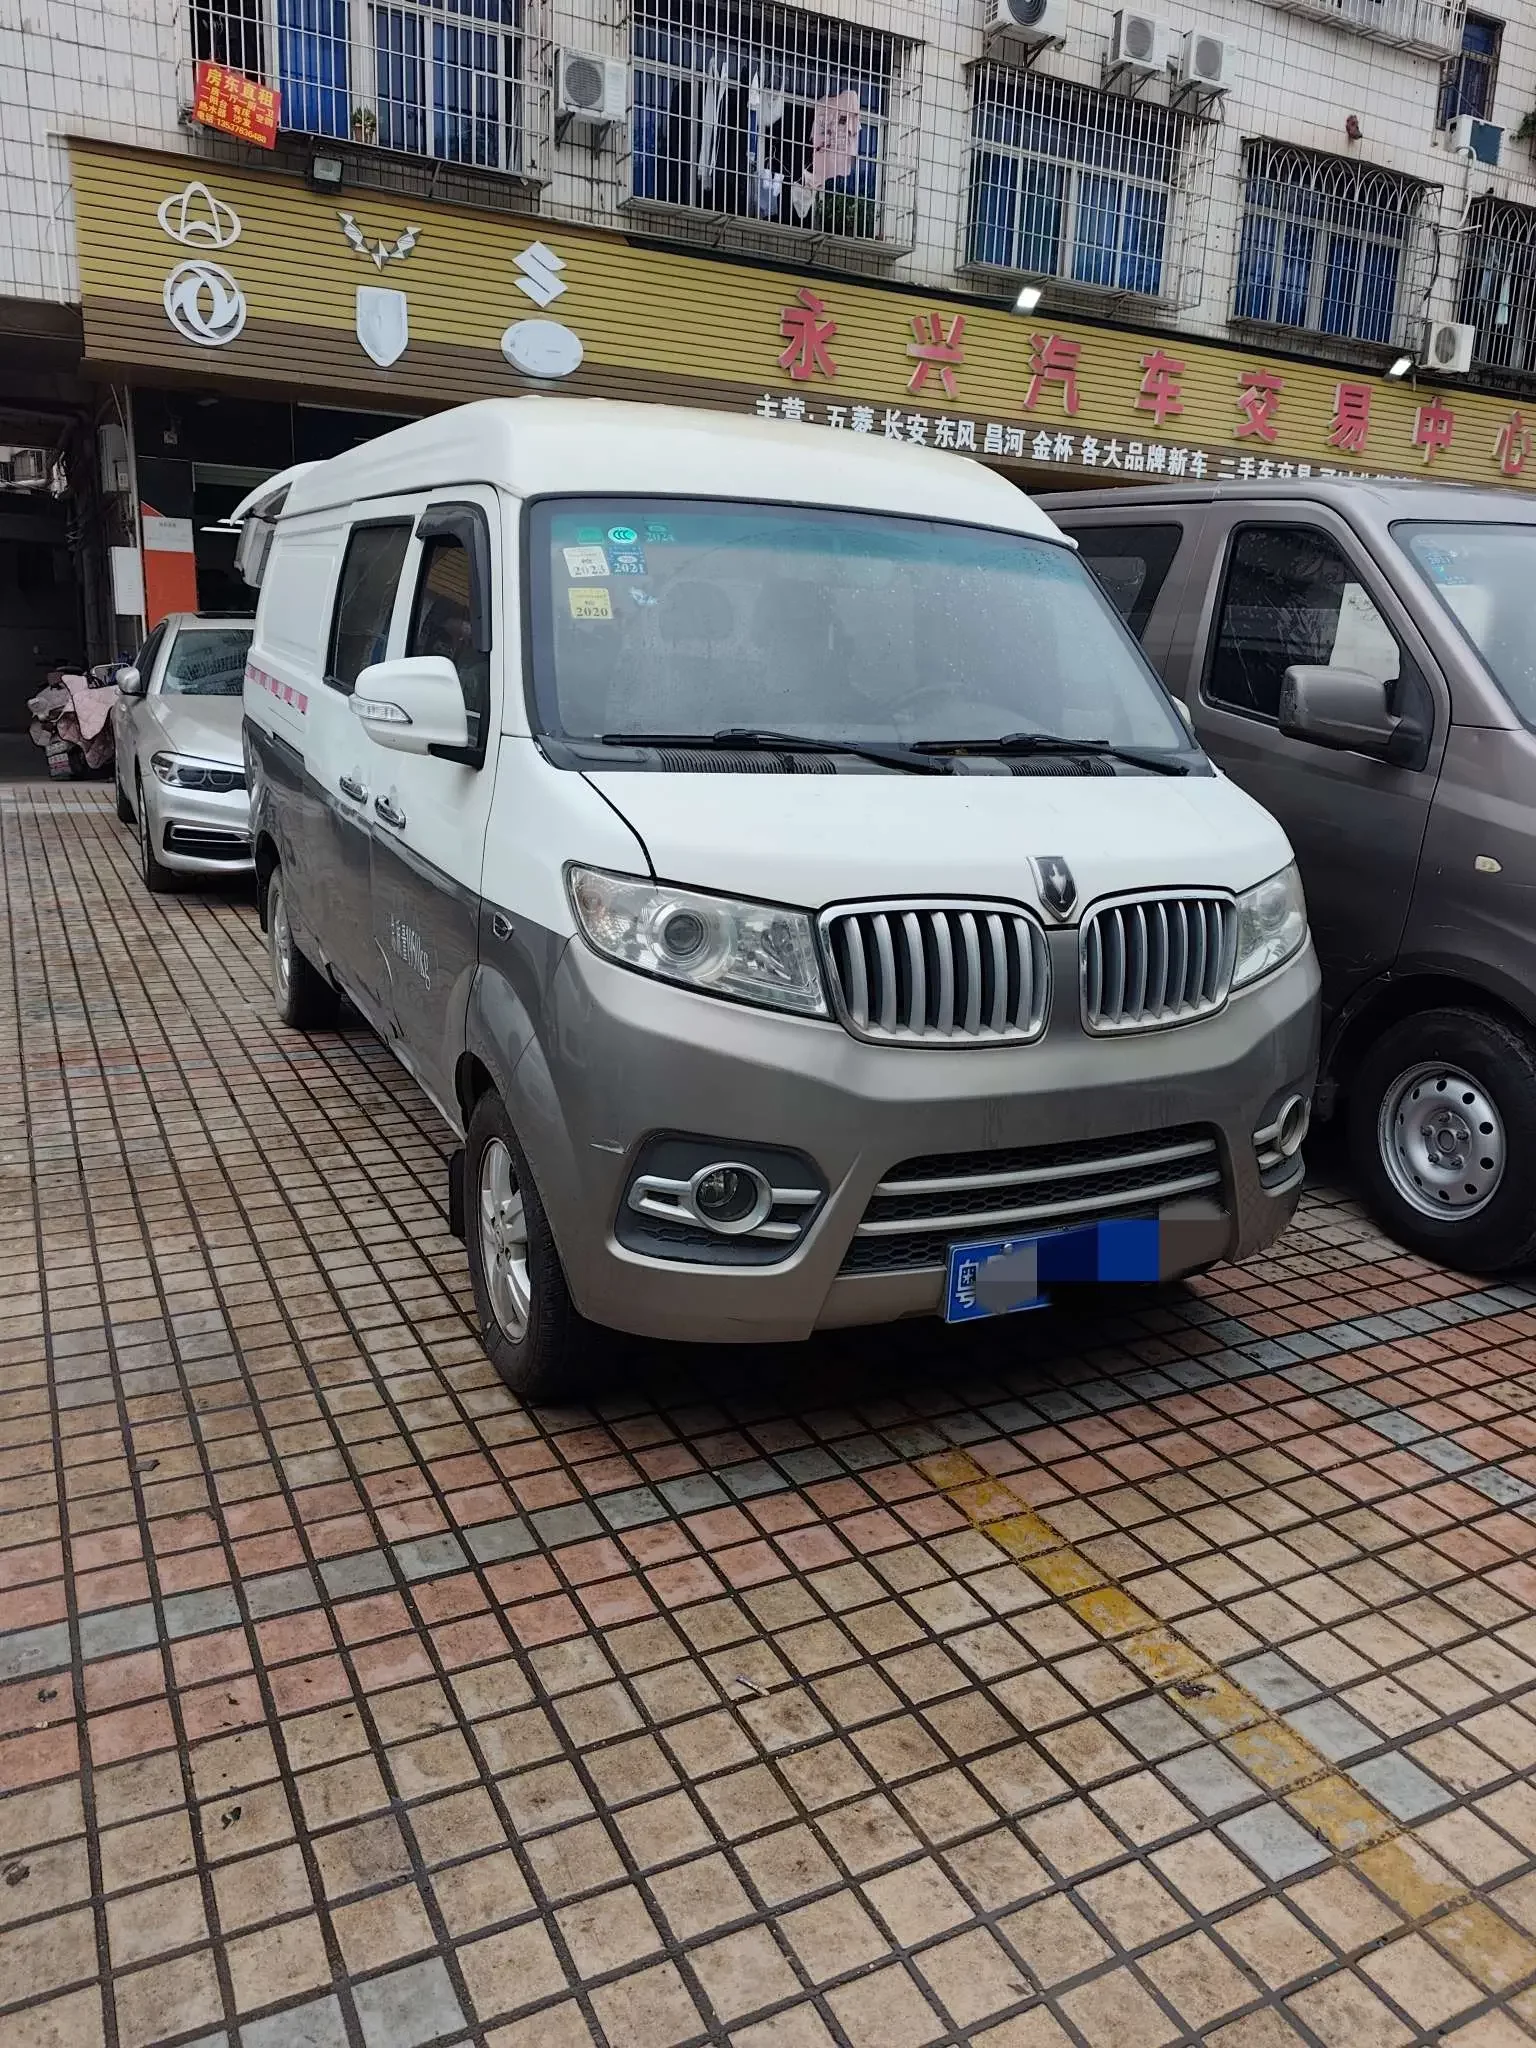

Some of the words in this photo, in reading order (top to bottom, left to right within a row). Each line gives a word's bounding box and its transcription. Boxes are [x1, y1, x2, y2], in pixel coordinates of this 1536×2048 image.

[206, 68, 273, 107] 房东直租
[778, 288, 1532, 474] 永兴汽车交易中心
[880, 408, 929, 446] 长安
[934, 415, 977, 451] 东风
[984, 423, 1026, 457] 昌河
[1031, 430, 1074, 462] 金杯
[1081, 434, 1209, 478] 各大品牌新车
[614, 563, 644, 573] 2021
[576, 607, 609, 617] 2020
